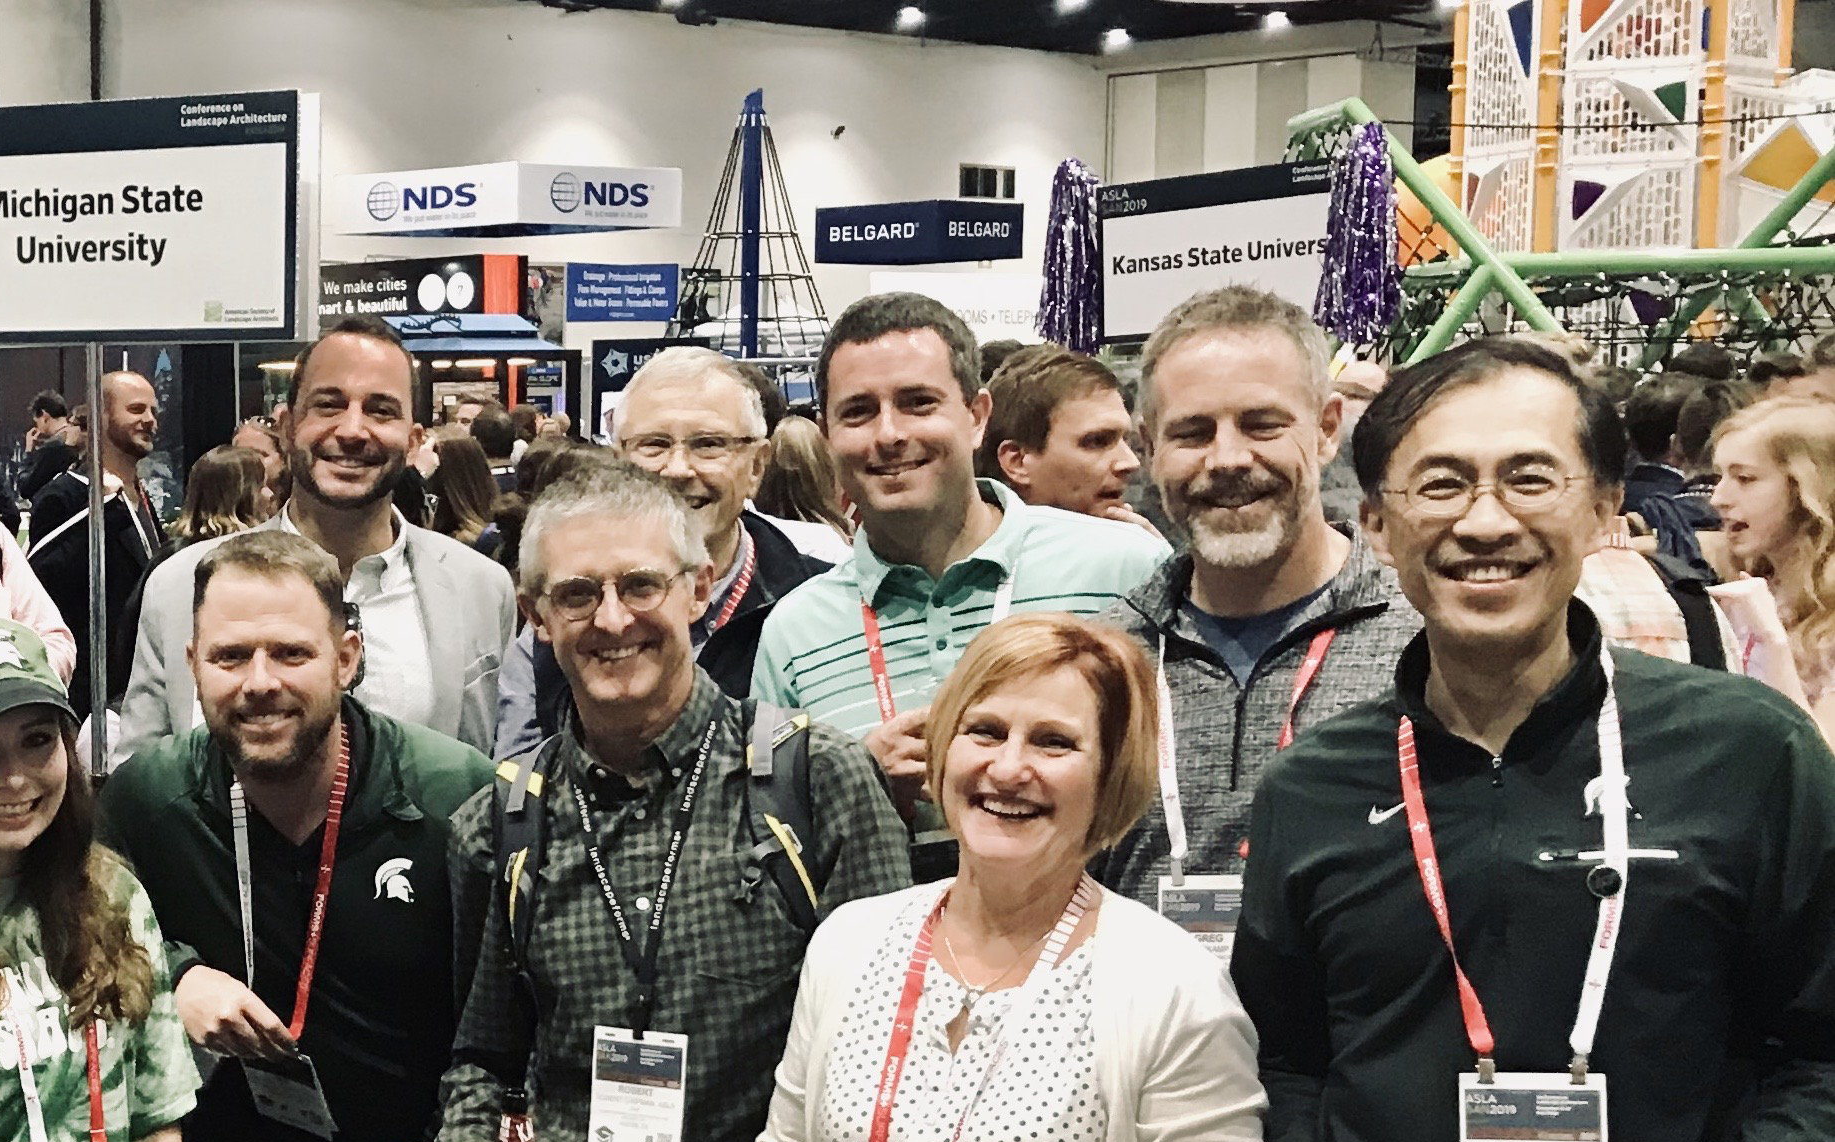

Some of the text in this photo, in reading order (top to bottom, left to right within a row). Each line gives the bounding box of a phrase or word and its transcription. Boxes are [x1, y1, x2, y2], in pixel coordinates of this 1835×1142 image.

[180, 103, 244, 115] Conference on
[180, 112, 287, 128] Landscape Architecture
[121, 185, 203, 214] State
[403, 182, 477, 211] NDS
[584, 181, 649, 207] NDS
[1101, 187, 1130, 203] ASLA
[829, 222, 916, 242] BELGARD
[948, 221, 1010, 238] BELGARD
[16, 233, 167, 267] University
[1112, 253, 1183, 275] Kansas
[1187, 244, 1243, 268] State
[324, 276, 407, 295] We make cities
[344, 299, 354, 314] &
[357, 296, 408, 313] beautiful
[680, 720, 717, 812] landscapeforms
[589, 846, 631, 941] landscapeforms
[649, 831, 681, 930] landscapeforms
